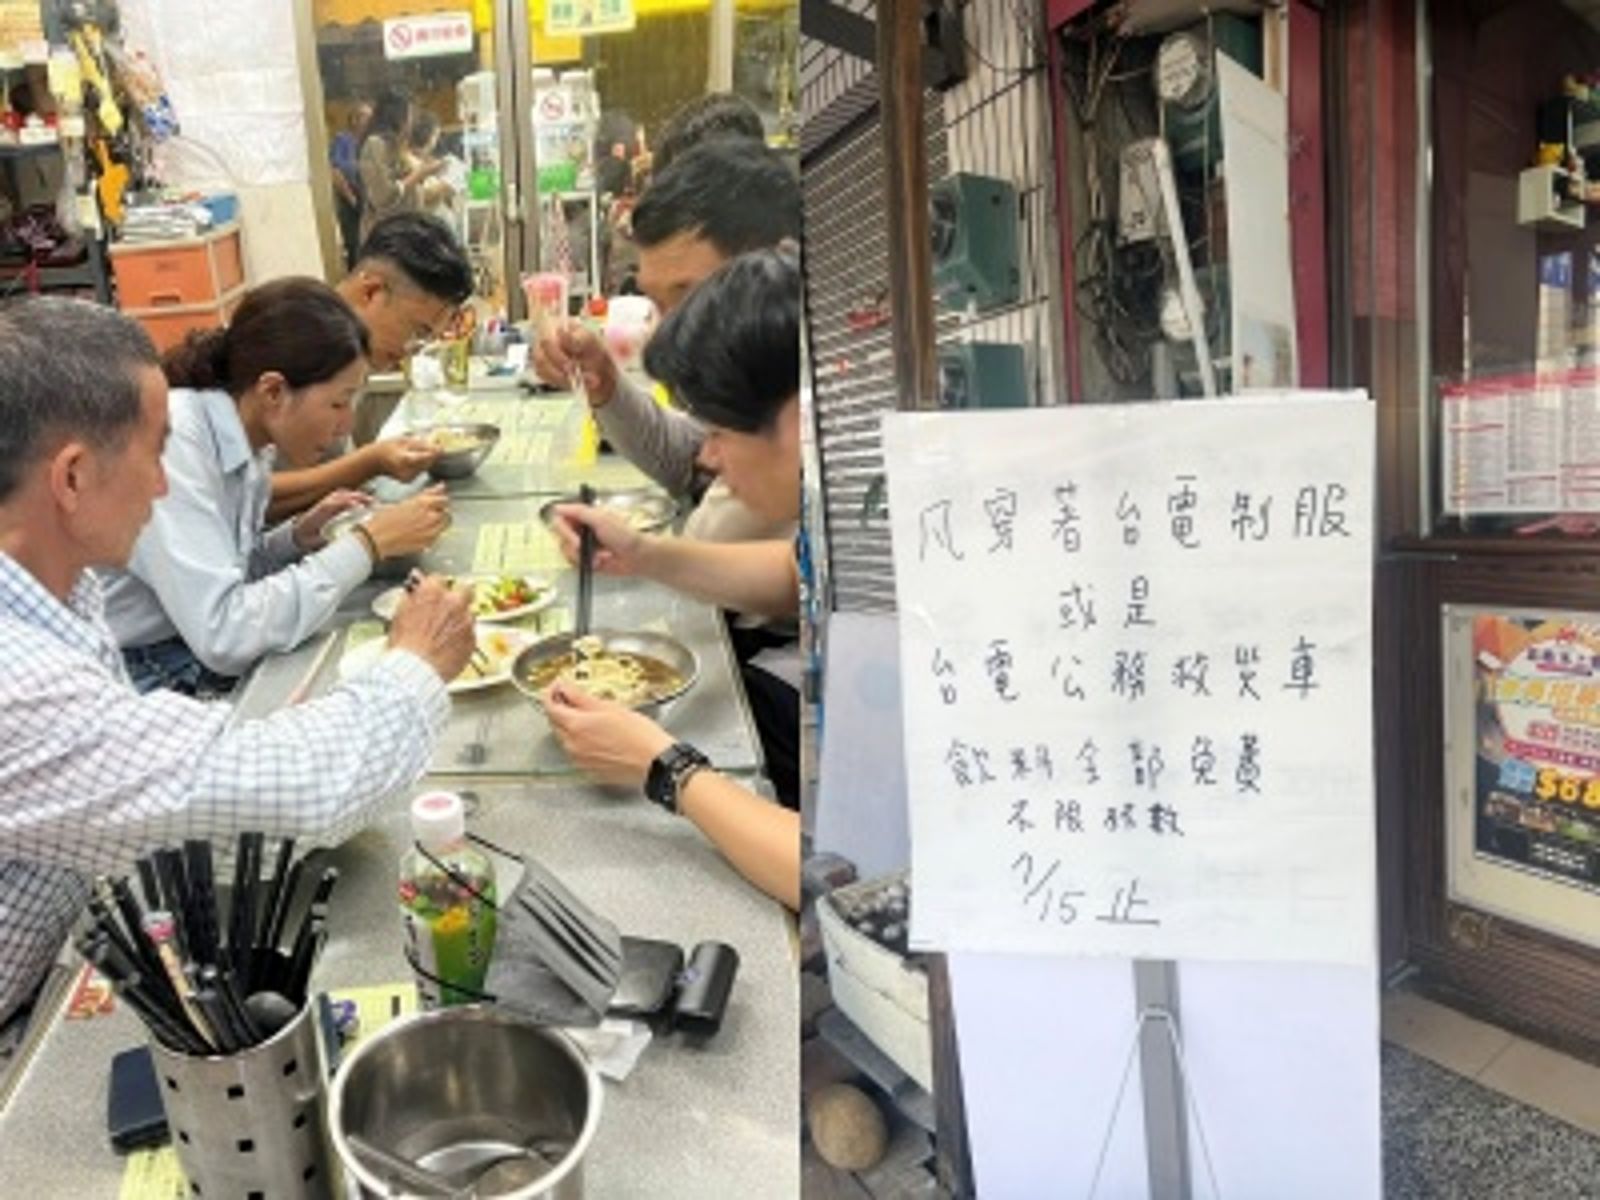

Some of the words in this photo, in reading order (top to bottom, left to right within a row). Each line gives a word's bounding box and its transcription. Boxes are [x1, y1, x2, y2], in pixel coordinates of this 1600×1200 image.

[1059, 574, 1157, 629] 或是
[931, 636, 1320, 705] 台電公務救災車
[945, 733, 1261, 794] 飲料全部免費
